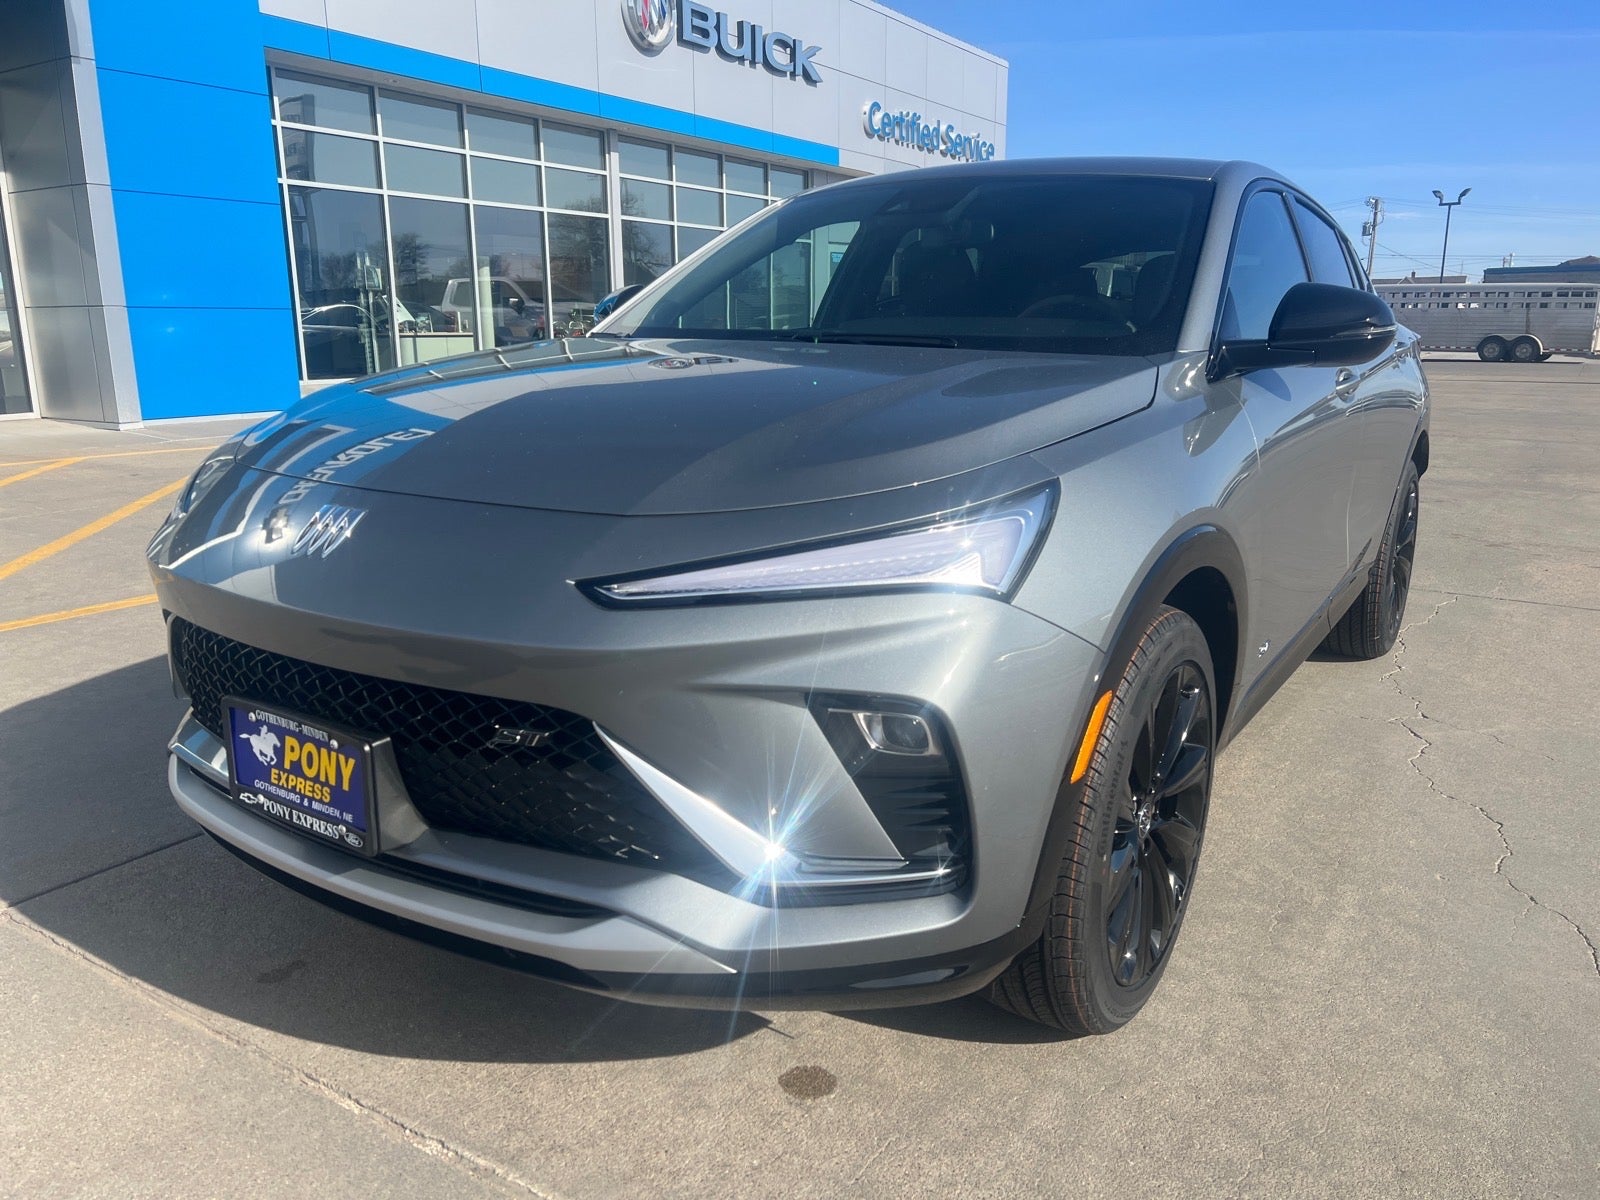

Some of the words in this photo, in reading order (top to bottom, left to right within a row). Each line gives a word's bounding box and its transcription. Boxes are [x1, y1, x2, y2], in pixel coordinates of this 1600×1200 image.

[678, 0, 823, 86] BUICK
[865, 101, 940, 152] Certified
[942, 124, 995, 162] Service
[270, 768, 331, 803] EXPRESS
[283, 735, 356, 791] PONY
[254, 779, 301, 803] GOTHENBURG
[303, 798, 309, 807] &
[311, 801, 342, 820] MINDEN,
[342, 812, 353, 823] NE
[263, 798, 290, 820] PONY
[292, 809, 340, 840] EXPRESS
